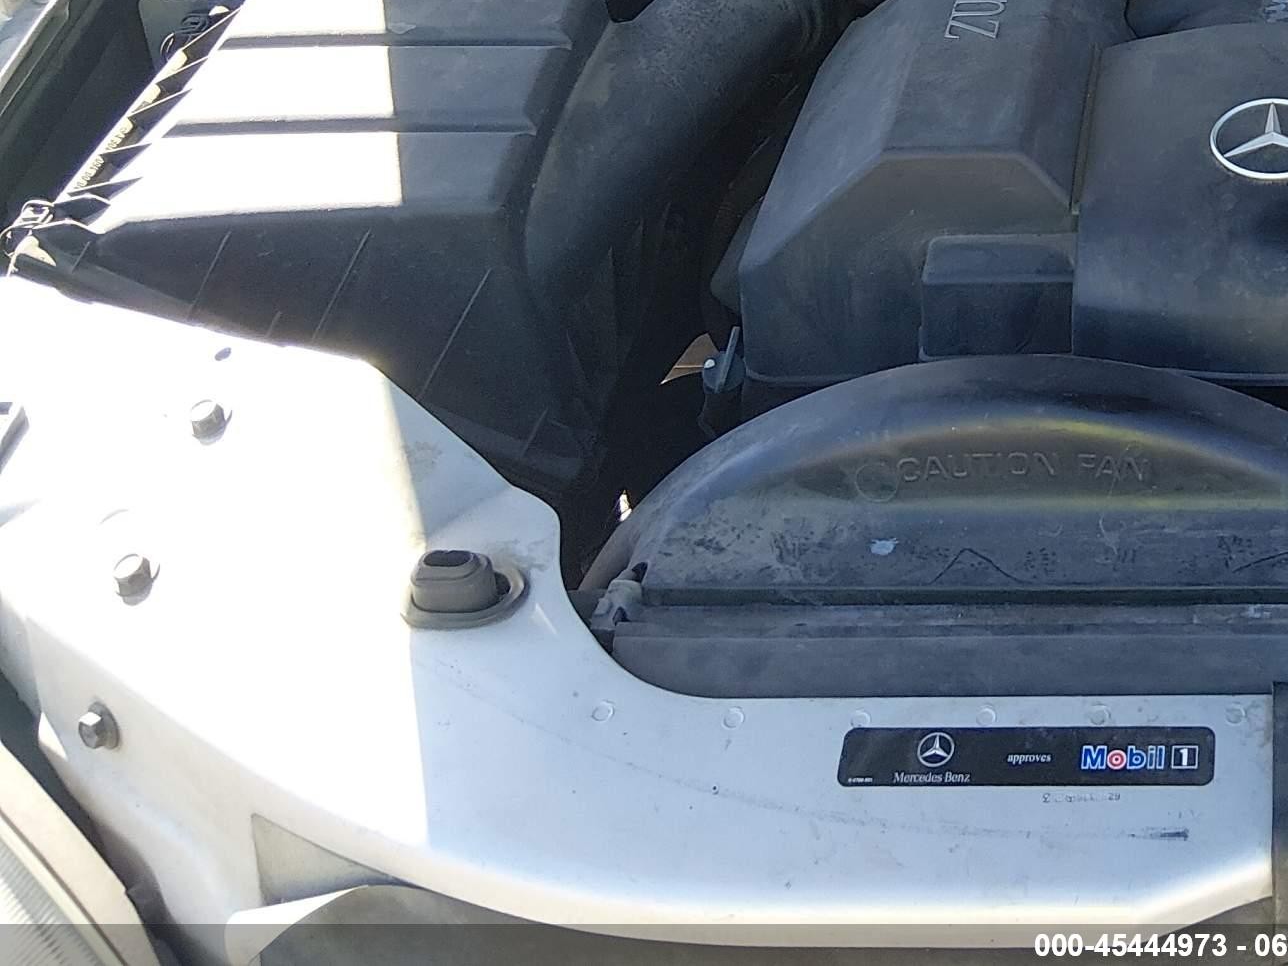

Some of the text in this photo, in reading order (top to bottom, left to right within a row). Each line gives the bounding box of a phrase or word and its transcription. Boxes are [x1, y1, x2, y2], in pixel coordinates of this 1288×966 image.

[895, 452, 1151, 483] CAUTION FAN
[1007, 752, 1052, 764] approves
[1080, 745, 1166, 770] Mobil
[893, 771, 971, 783] Mercedes Benz
